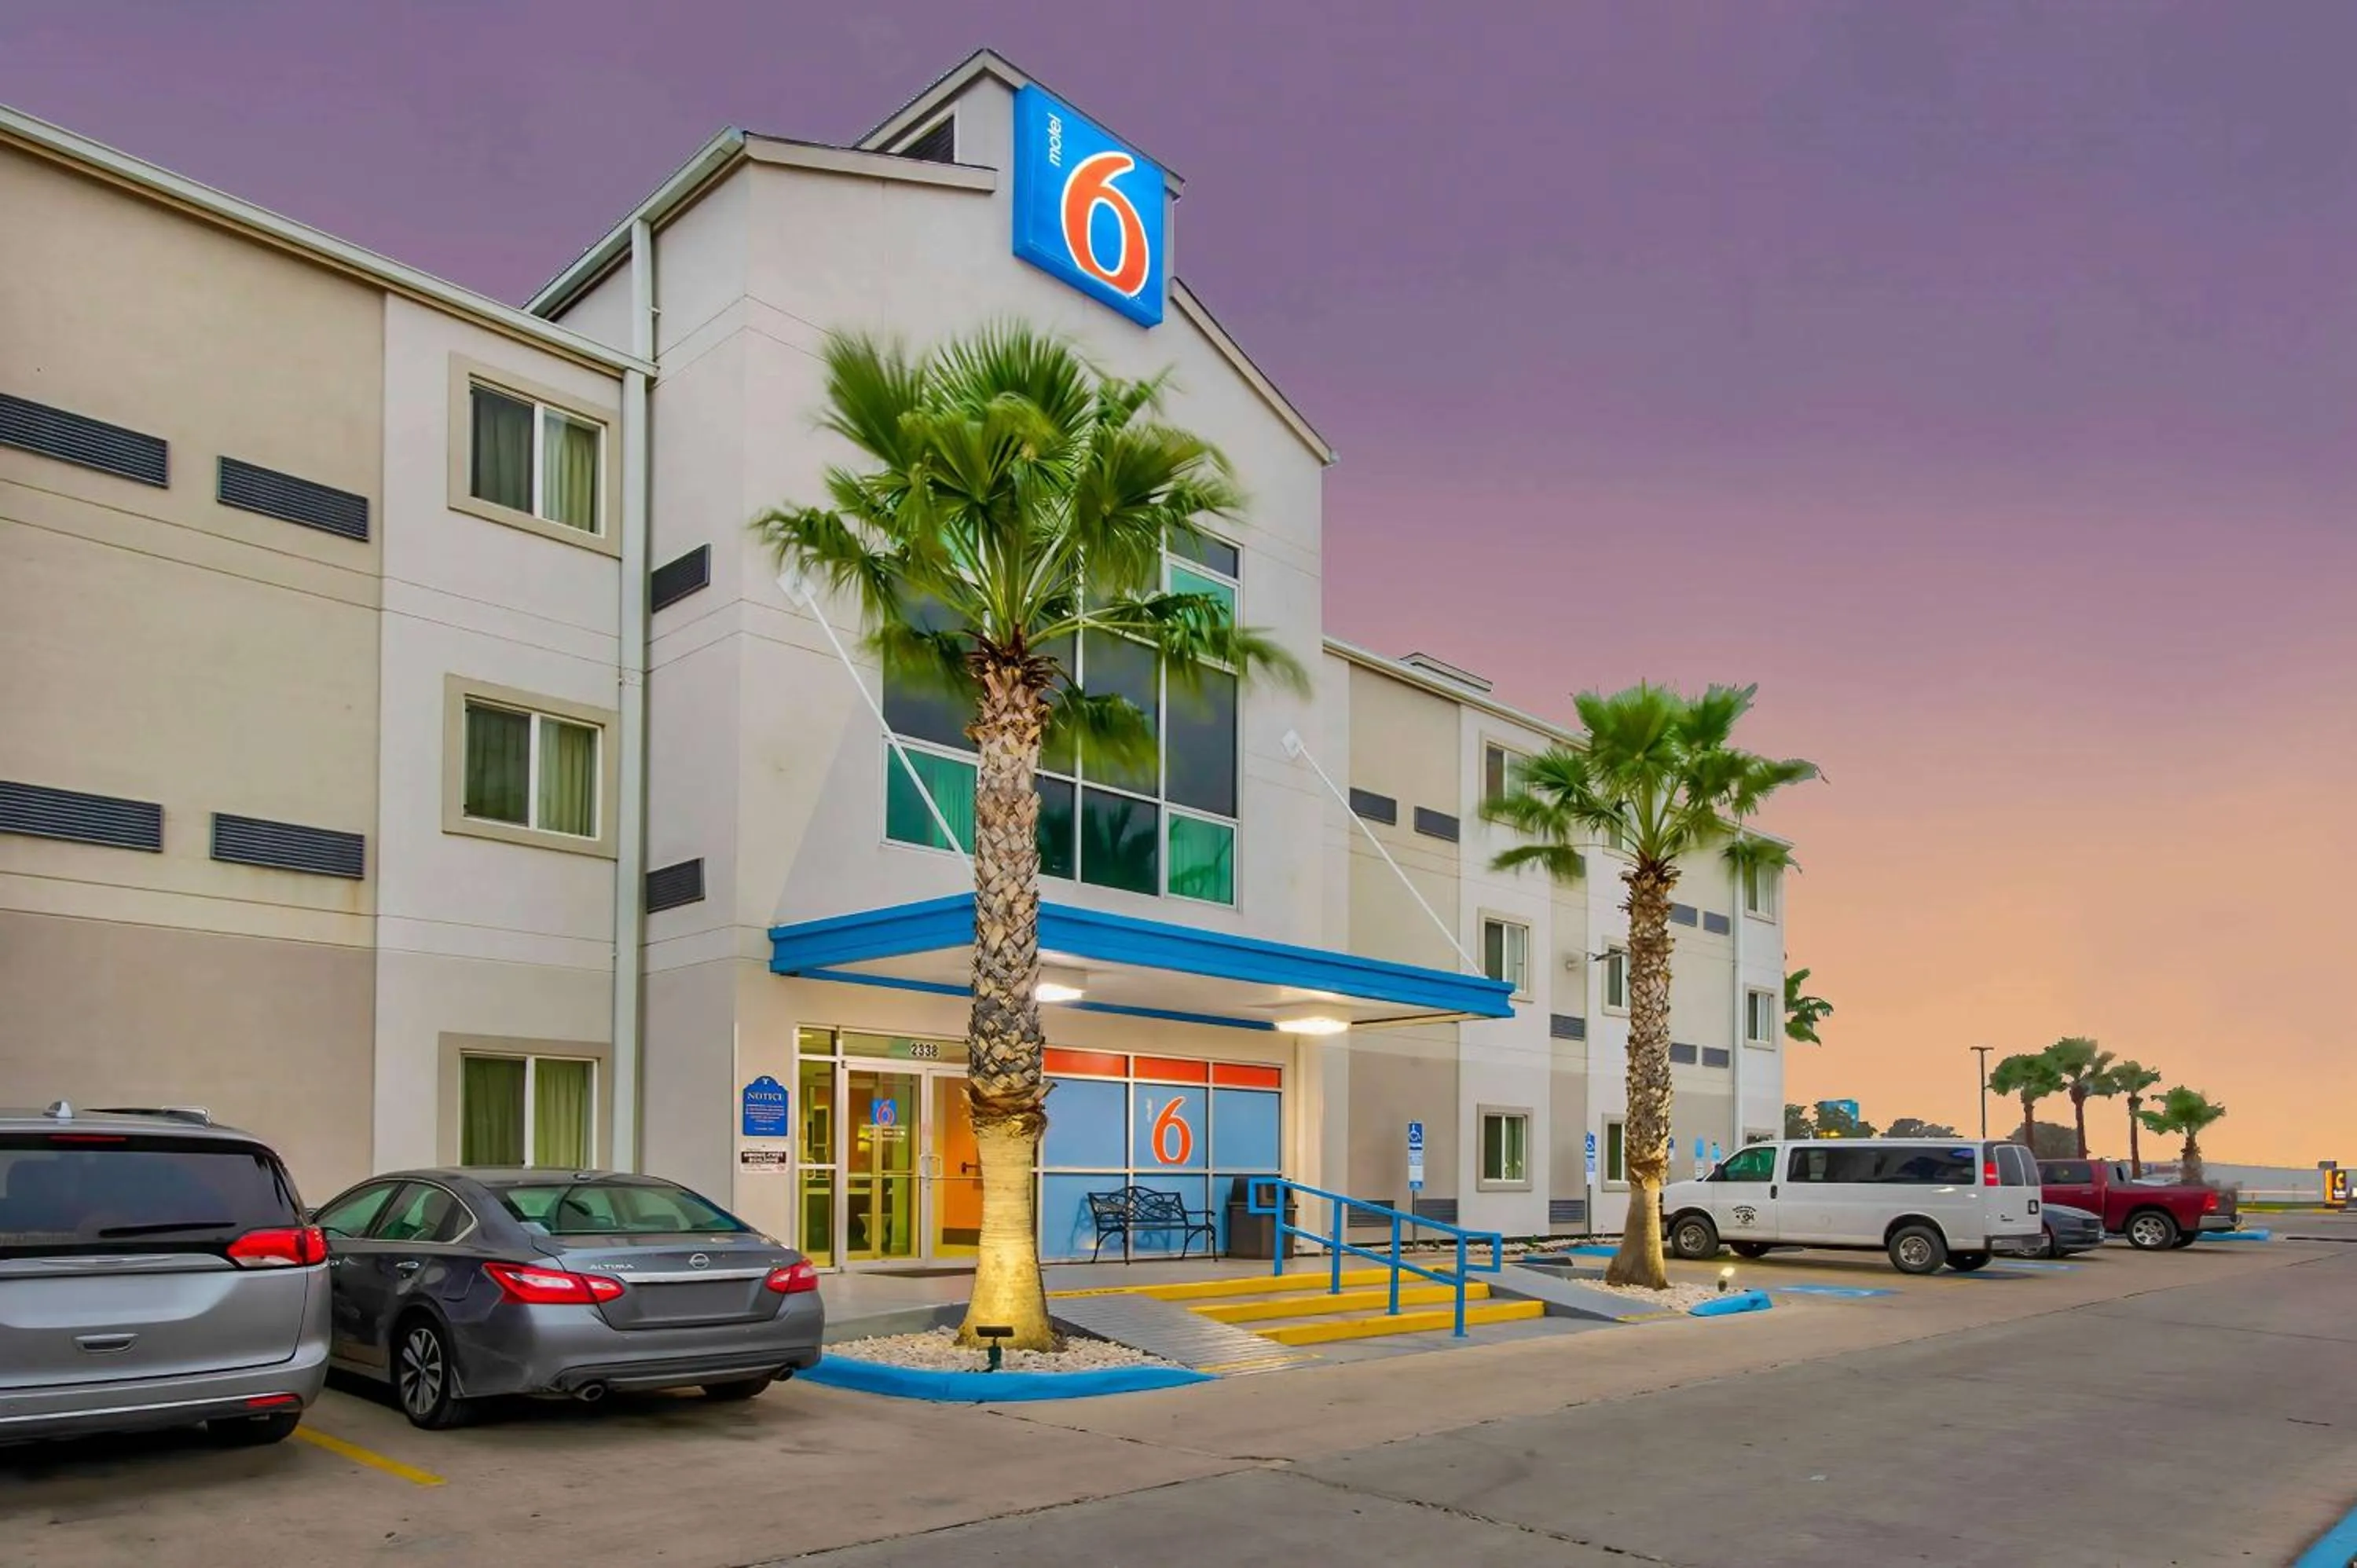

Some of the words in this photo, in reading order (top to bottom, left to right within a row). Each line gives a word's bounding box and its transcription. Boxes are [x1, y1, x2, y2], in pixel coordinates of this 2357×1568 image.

[1047, 112, 1062, 167] motel
[1061, 151, 1149, 299] 6
[911, 1042, 939, 1057] 2338
[875, 1099, 895, 1127] 6
[1150, 1095, 1193, 1165] 6
